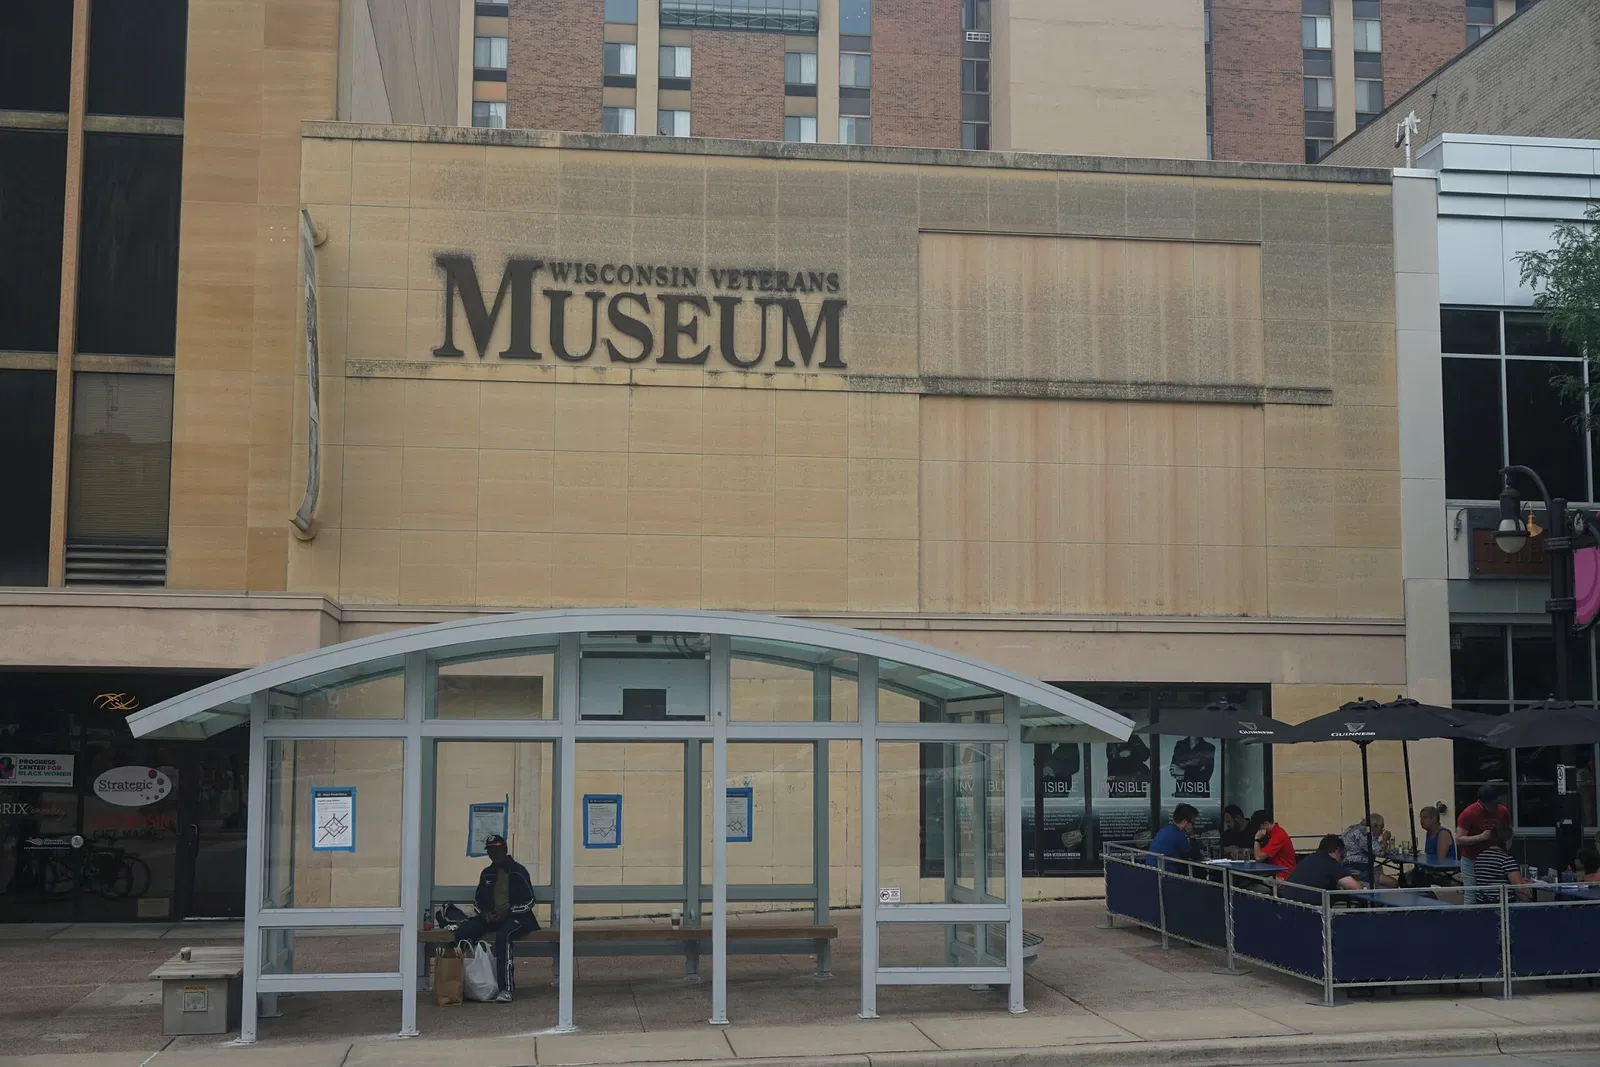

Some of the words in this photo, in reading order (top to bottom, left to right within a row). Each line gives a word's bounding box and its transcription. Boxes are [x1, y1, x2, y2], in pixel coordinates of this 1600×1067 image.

[548, 261, 699, 287] WISCONSIN
[709, 268, 841, 293] VETERANS
[433, 255, 848, 368] MUSEUM
[98, 779, 153, 792] Strategic
